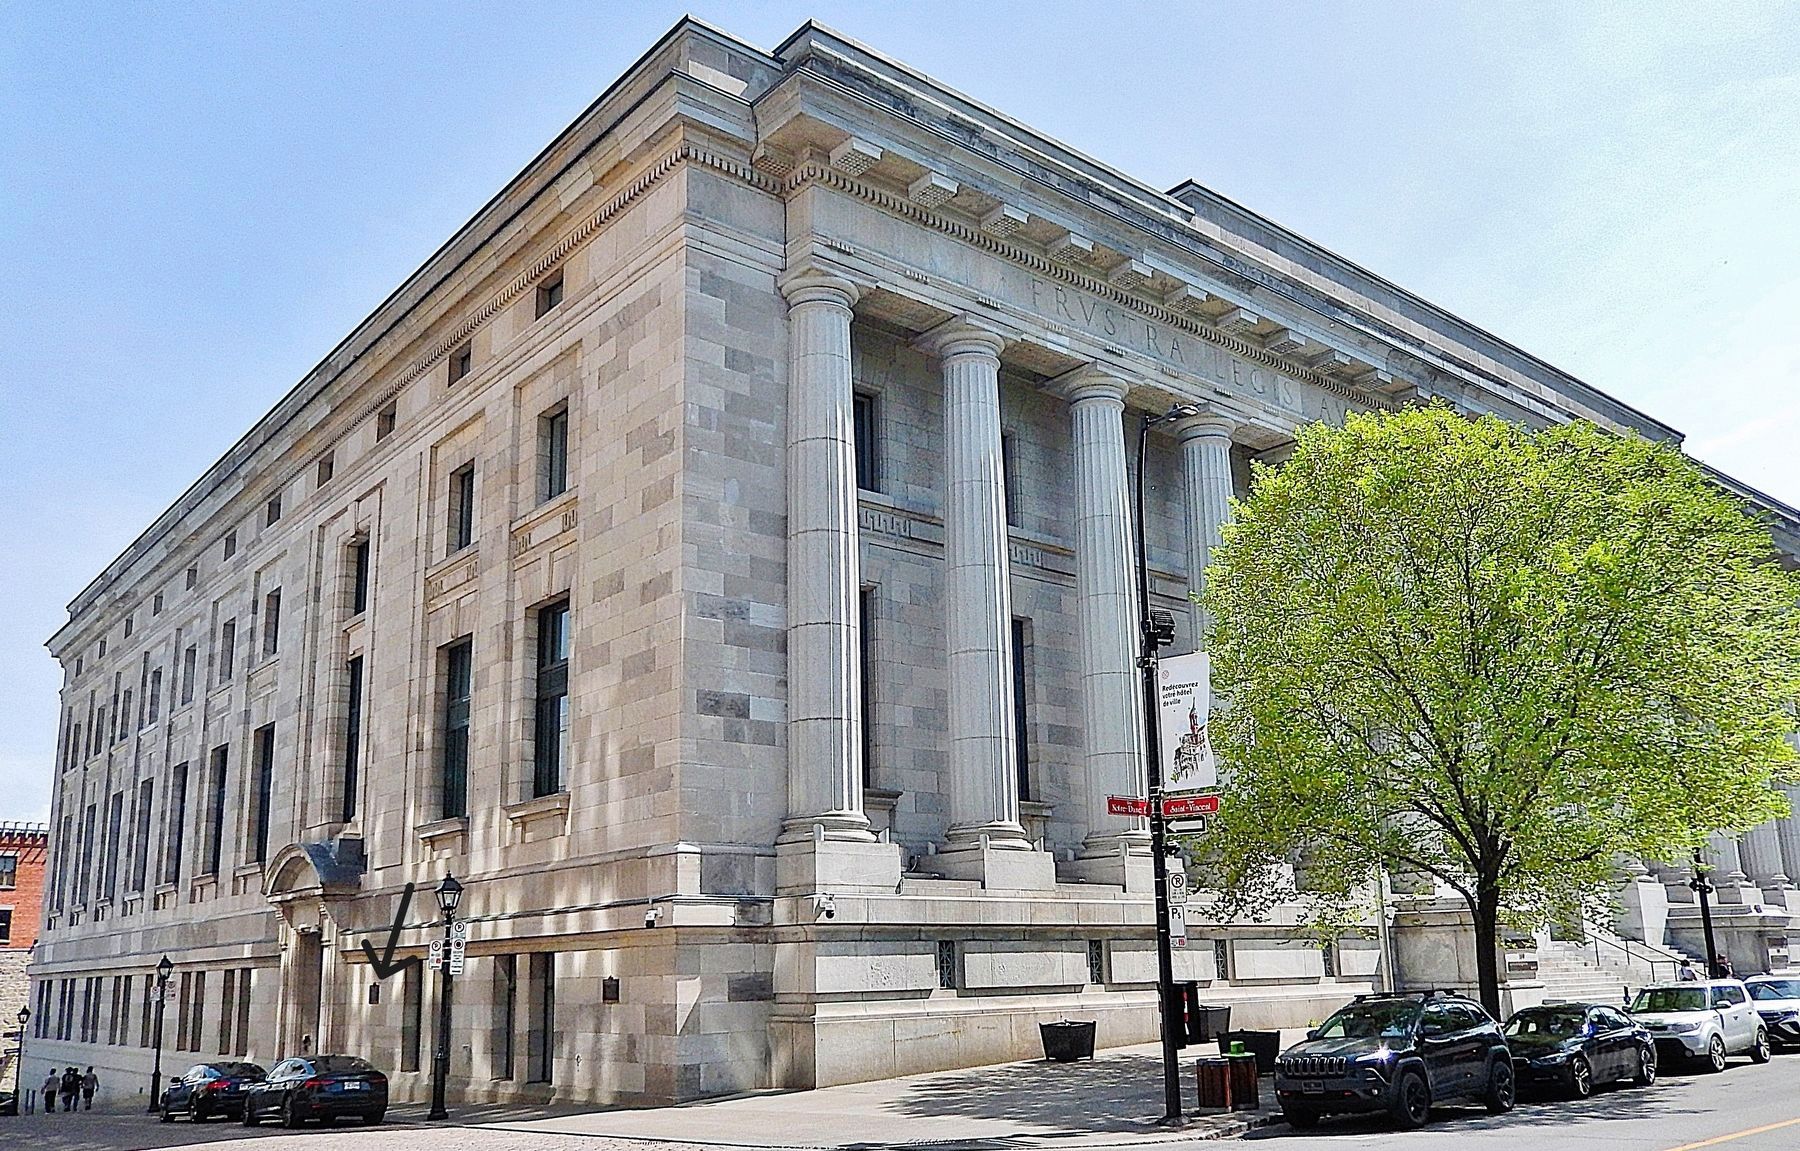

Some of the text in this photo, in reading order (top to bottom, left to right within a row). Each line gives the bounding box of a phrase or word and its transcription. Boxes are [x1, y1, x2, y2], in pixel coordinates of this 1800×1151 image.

[1032, 278, 1186, 362] FRVSTRA
[1213, 350, 1293, 405] LEGIS
[1162, 682, 1199, 692] Redécouvrez
[1169, 803, 1211, 814] Saint-Vincent
